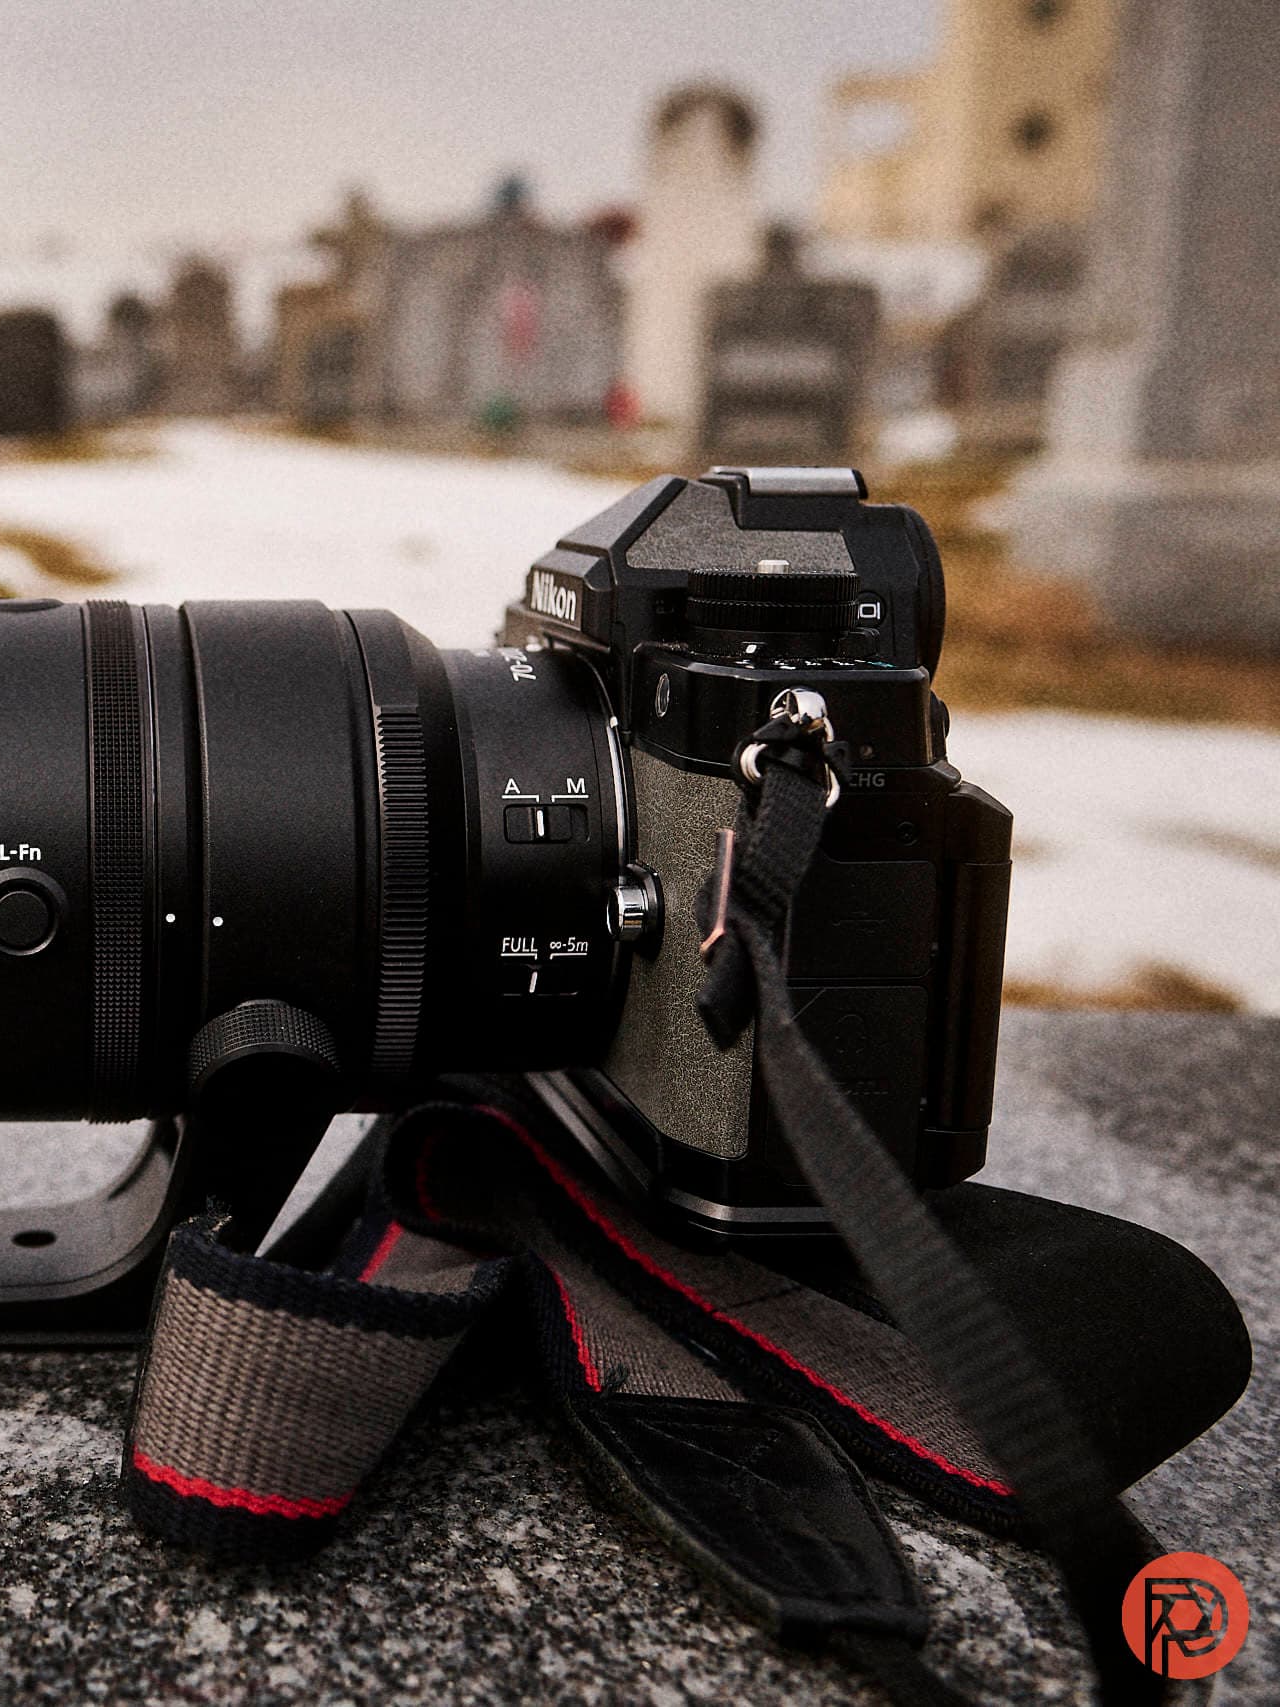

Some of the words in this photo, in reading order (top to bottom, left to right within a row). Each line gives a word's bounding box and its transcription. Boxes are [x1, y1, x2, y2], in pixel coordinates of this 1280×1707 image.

[530, 569, 577, 622] Nikon
[504, 777, 521, 794] A
[566, 777, 587, 794] M
[0, 843, 42, 861] L-Fn
[501, 937, 539, 953] FULL
